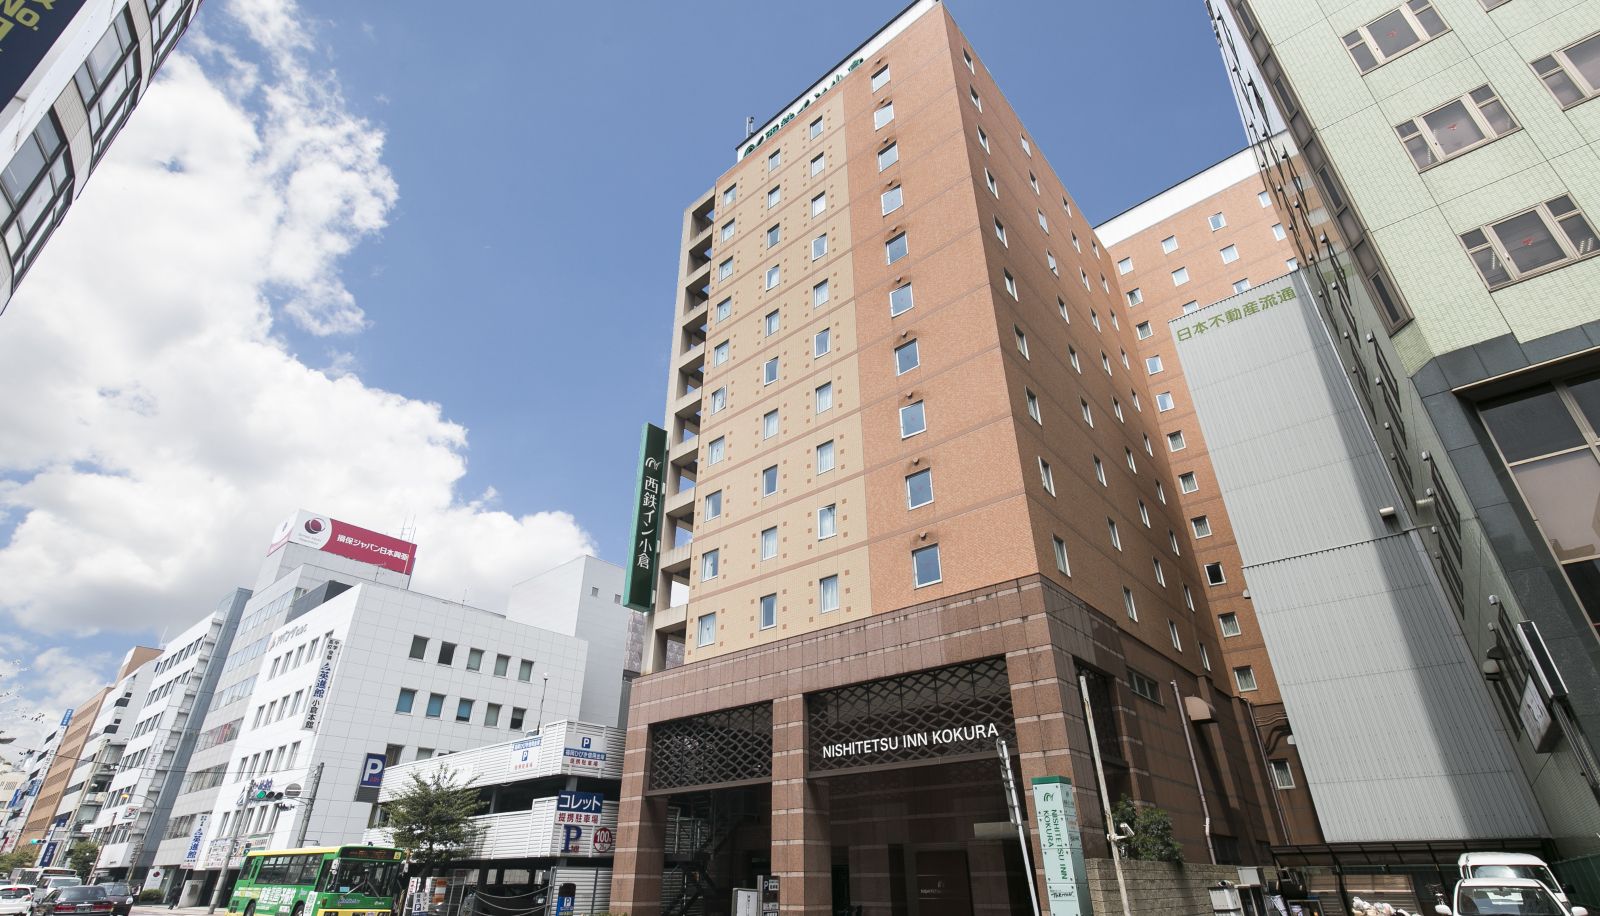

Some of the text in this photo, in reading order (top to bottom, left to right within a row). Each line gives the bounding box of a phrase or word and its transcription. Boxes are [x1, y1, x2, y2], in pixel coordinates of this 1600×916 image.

[1176, 286, 1297, 342] 日本不動産流通
[637, 475, 659, 570] 西鉄イン小倉
[822, 722, 999, 759] NISHITETSU INN KOKURA
[363, 758, 383, 782] P
[558, 812, 599, 824] 提携駐車場
[559, 794, 601, 811] コレット
[561, 824, 583, 853] P
[1043, 810, 1054, 848] KOKURA
[1051, 809, 1065, 861] NISHITETSU
[1060, 863, 1068, 880] INN
